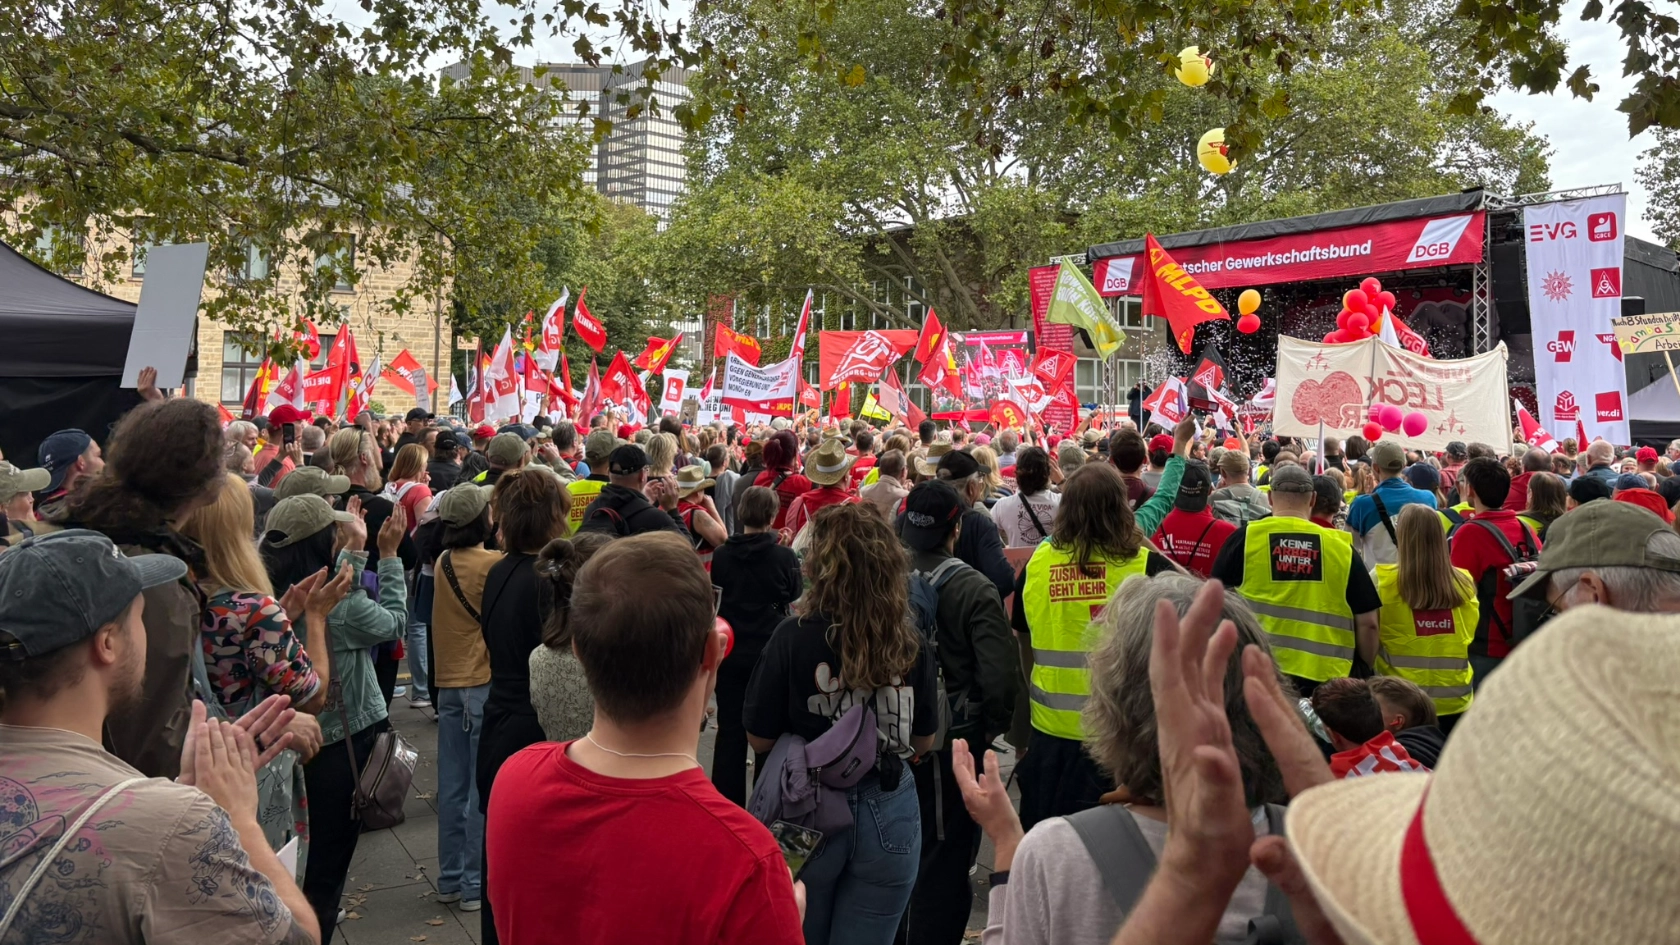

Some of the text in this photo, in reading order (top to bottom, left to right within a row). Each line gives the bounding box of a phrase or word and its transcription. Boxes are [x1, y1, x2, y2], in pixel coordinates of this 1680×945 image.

[1530, 221, 1577, 242] EVG
[1180, 240, 1372, 274] tscher Gewerkschaftsbund
[1415, 242, 1450, 259] DGB
[1106, 278, 1127, 289] DGB
[1155, 263, 1222, 315] MLPD
[1627, 316, 1635, 326] 8
[1547, 340, 1577, 353] GEW
[1597, 408, 1620, 418] ver.di
[570, 507, 586, 518] GEH
[1175, 539, 1211, 549] VERTRAUENLEUTE
[1279, 538, 1313, 551] KEINE
[1272, 545, 1320, 560] ARBEIT
[1278, 554, 1311, 565] UNTER
[1275, 560, 1314, 574] WERT
[1049, 581, 1107, 598] GEHT MEHR
[1416, 618, 1451, 629] ver.di
